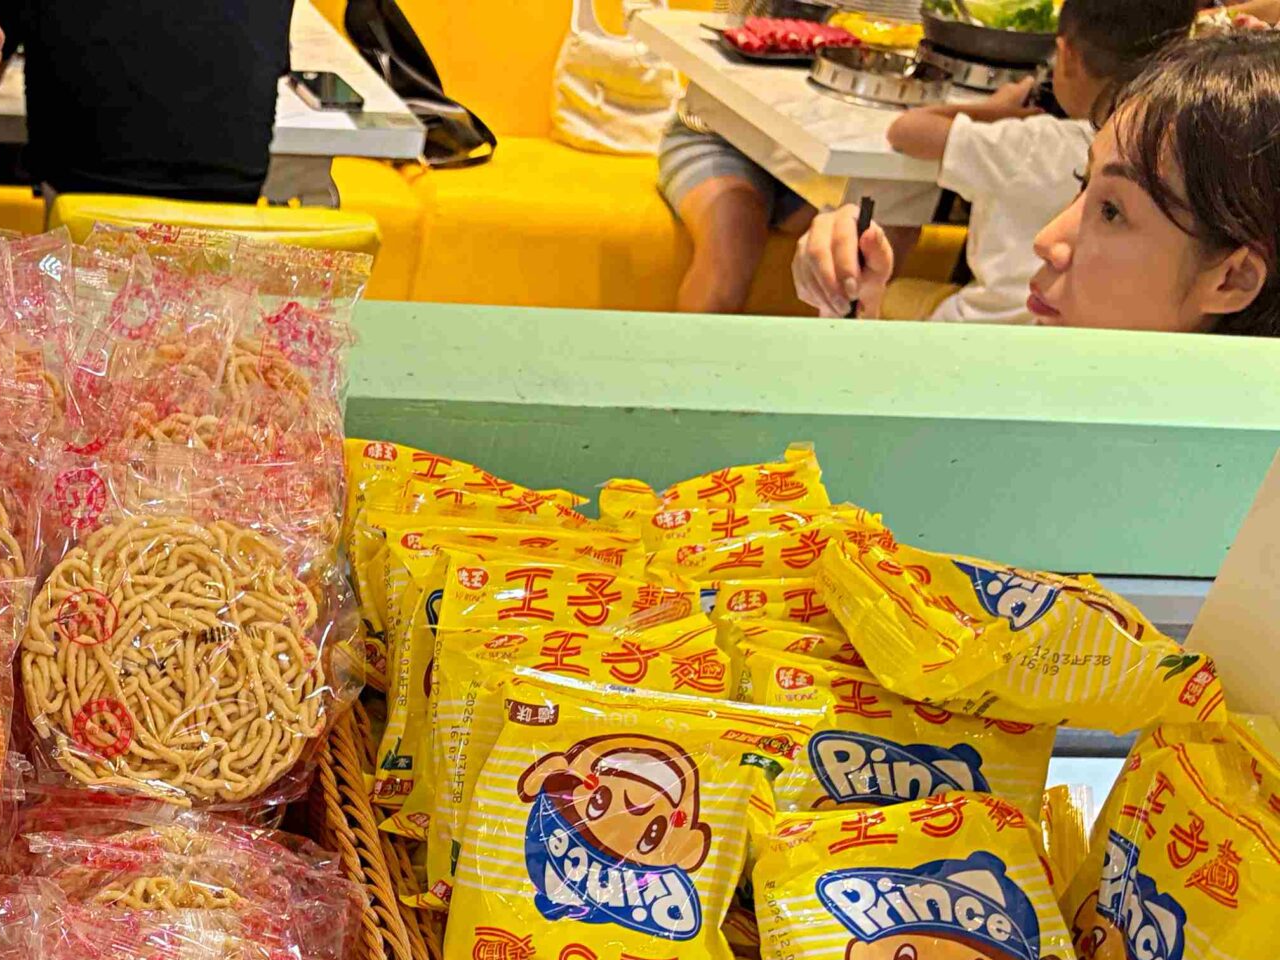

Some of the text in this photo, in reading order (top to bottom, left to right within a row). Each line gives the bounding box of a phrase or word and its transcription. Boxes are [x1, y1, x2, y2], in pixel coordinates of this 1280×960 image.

[530, 630, 726, 693] 王子麵
[548, 826, 696, 937] Prince
[823, 876, 1013, 942] Prince
